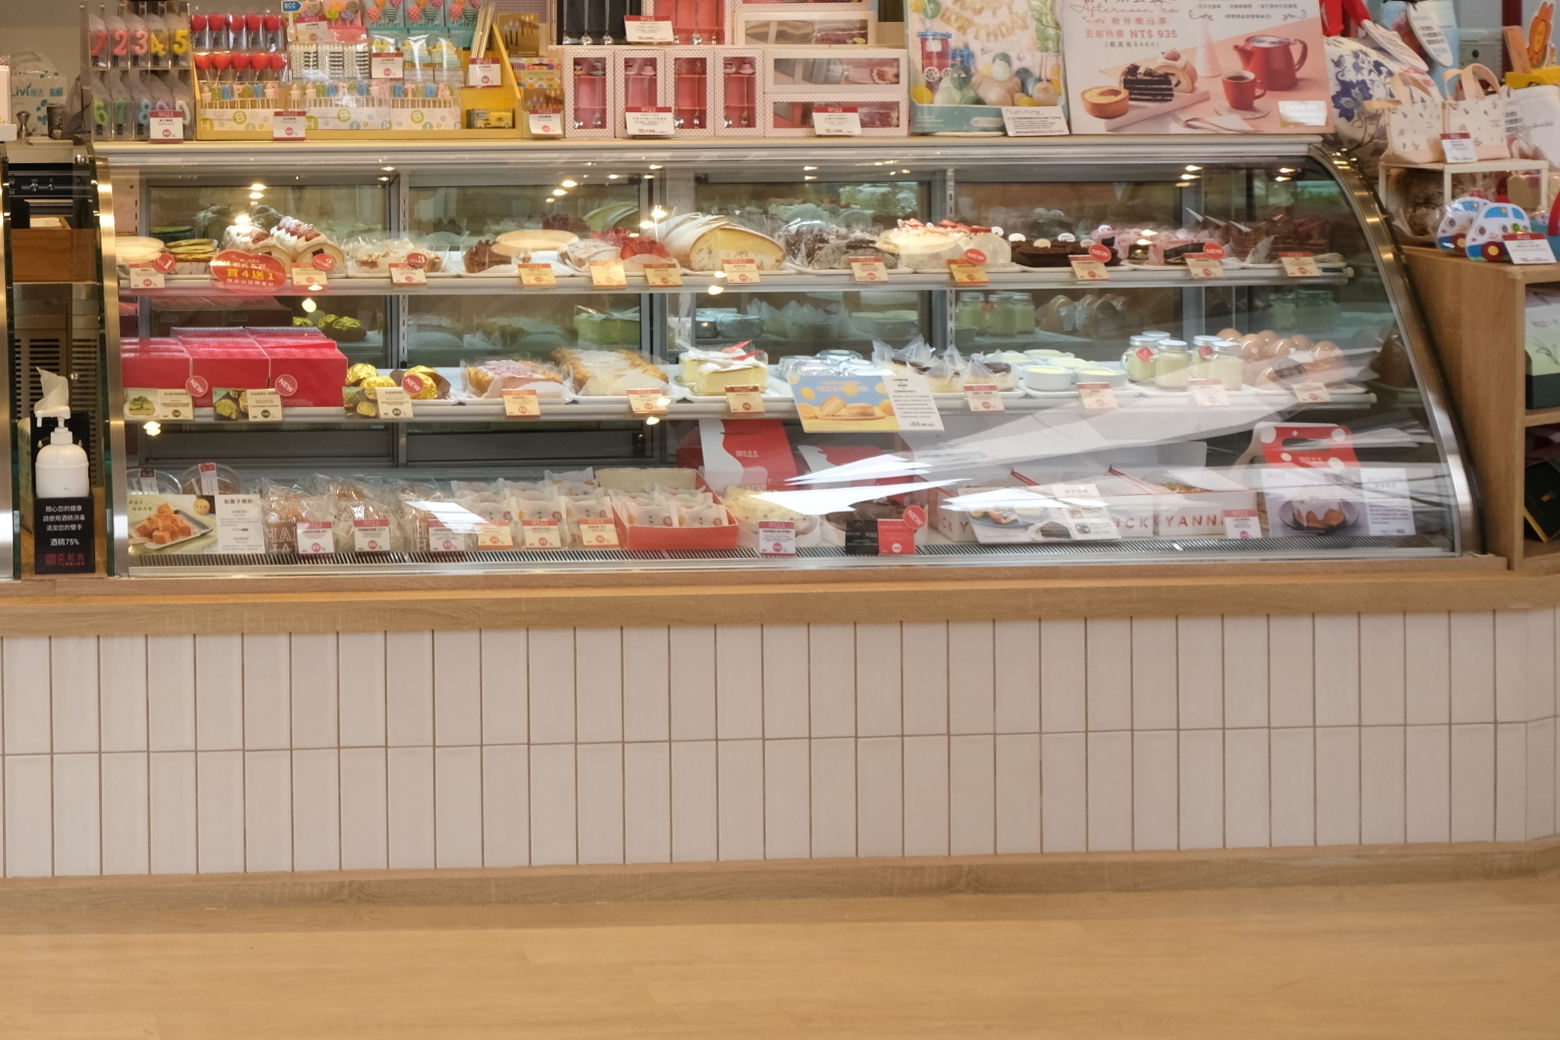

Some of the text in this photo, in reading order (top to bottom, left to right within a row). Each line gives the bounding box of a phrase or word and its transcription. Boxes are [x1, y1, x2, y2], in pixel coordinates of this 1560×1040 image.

[1130, 29, 1153, 39] NT$
[1157, 29, 1178, 39] 935
[966, 252, 985, 261] NEW
[1091, 248, 1109, 259] NEW
[1205, 248, 1224, 256] NEW
[188, 378, 206, 394] NEW
[277, 377, 295, 393] NEW
[405, 377, 421, 391] NEW
[43, 514, 85, 522] 請使用酒精消毒
[906, 509, 923, 526] NEW
[50, 538, 80, 546] 酒精75%
